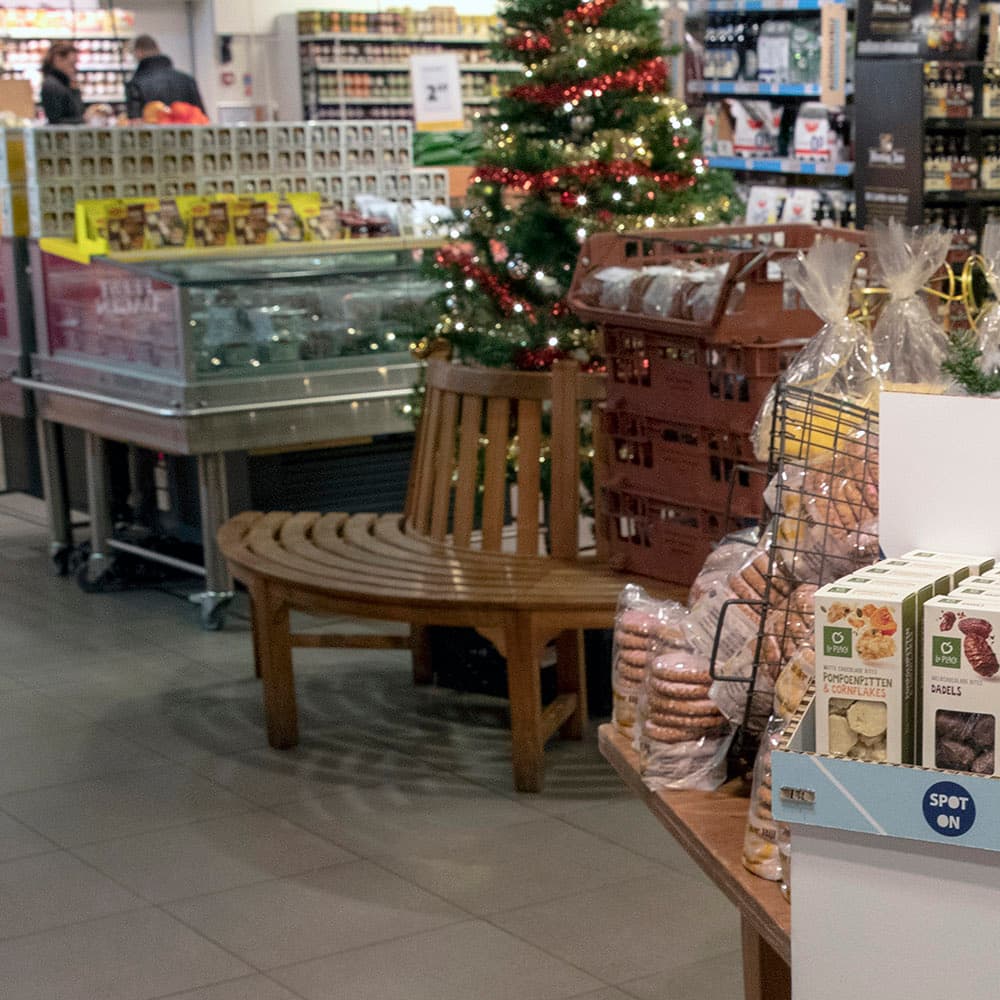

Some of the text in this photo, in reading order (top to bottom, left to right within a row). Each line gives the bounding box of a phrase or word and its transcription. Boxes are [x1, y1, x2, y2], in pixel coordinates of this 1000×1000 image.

[823, 671, 893, 688] POMPOENPITTEN
[831, 684, 887, 698] CORNFLAKES
[931, 683, 962, 697] DADELS
[929, 793, 969, 811] SPOT
[936, 814, 961, 830] ON
